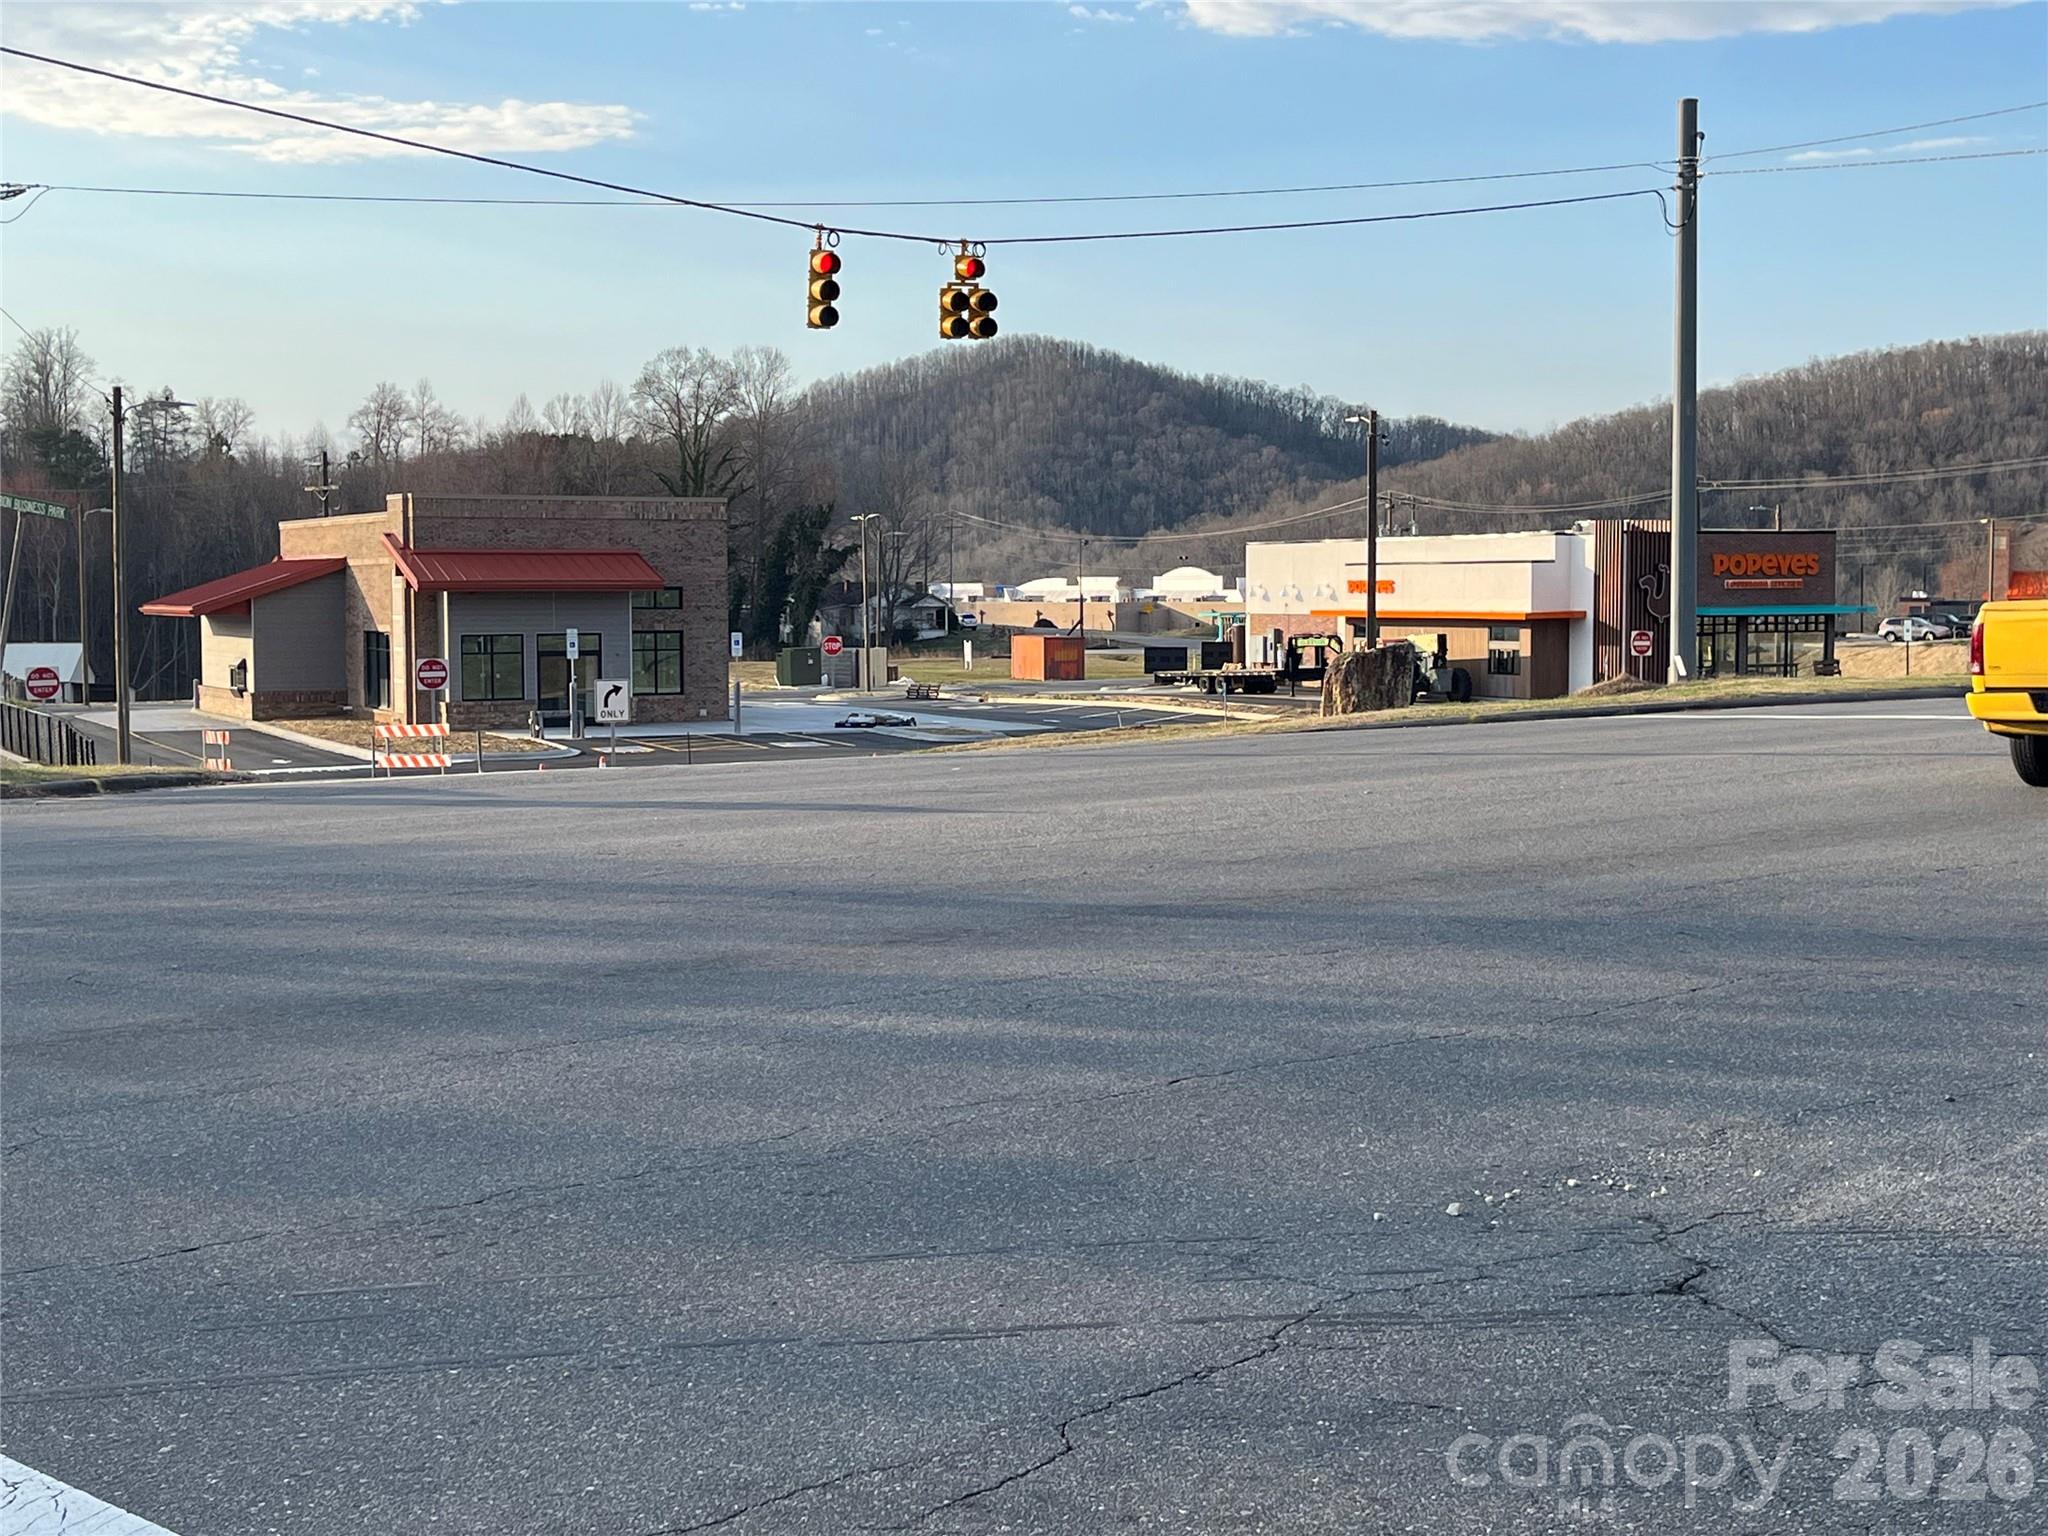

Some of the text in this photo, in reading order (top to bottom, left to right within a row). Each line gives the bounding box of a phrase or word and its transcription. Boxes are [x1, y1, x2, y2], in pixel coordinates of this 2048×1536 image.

[13, 499, 46, 515] BUSINESS
[47, 504, 66, 519] PARK
[824, 642, 841, 650] STOP
[600, 710, 625, 719] ONLY
